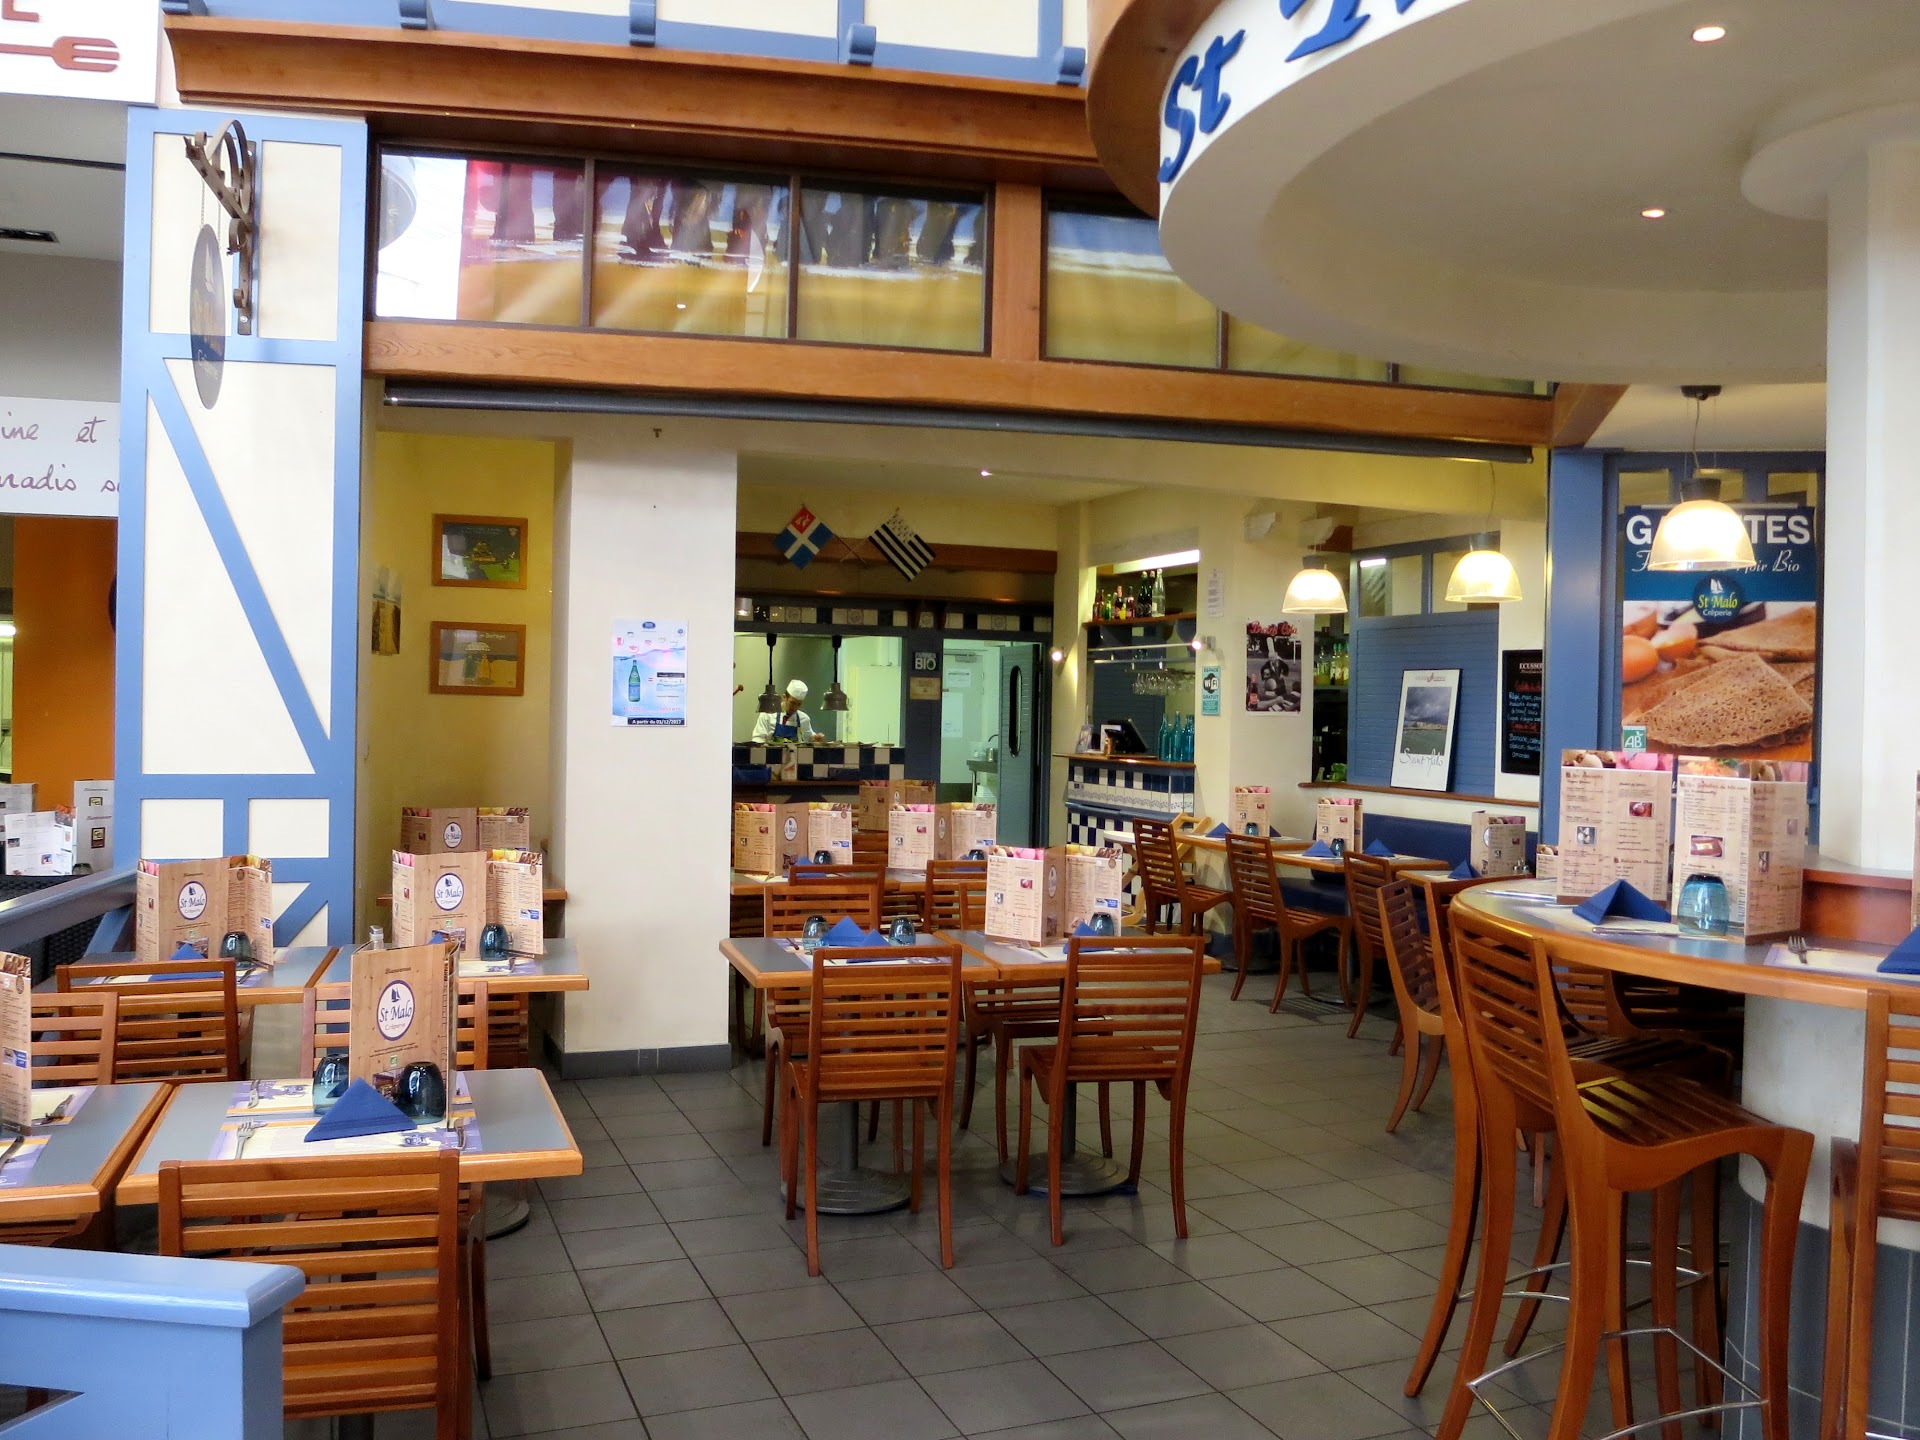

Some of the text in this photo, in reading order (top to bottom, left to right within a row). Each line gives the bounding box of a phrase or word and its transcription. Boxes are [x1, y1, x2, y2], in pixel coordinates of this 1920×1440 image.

[1157, 29, 1246, 183] St
[75, 416, 107, 444] et
[1772, 549, 1800, 573] Bio
[1697, 591, 1738, 609] St Malo
[1702, 608, 1732, 617] Crêperie
[915, 657, 936, 670] BIO
[436, 885, 462, 899] St Malo
[379, 999, 413, 1023] St Malo
